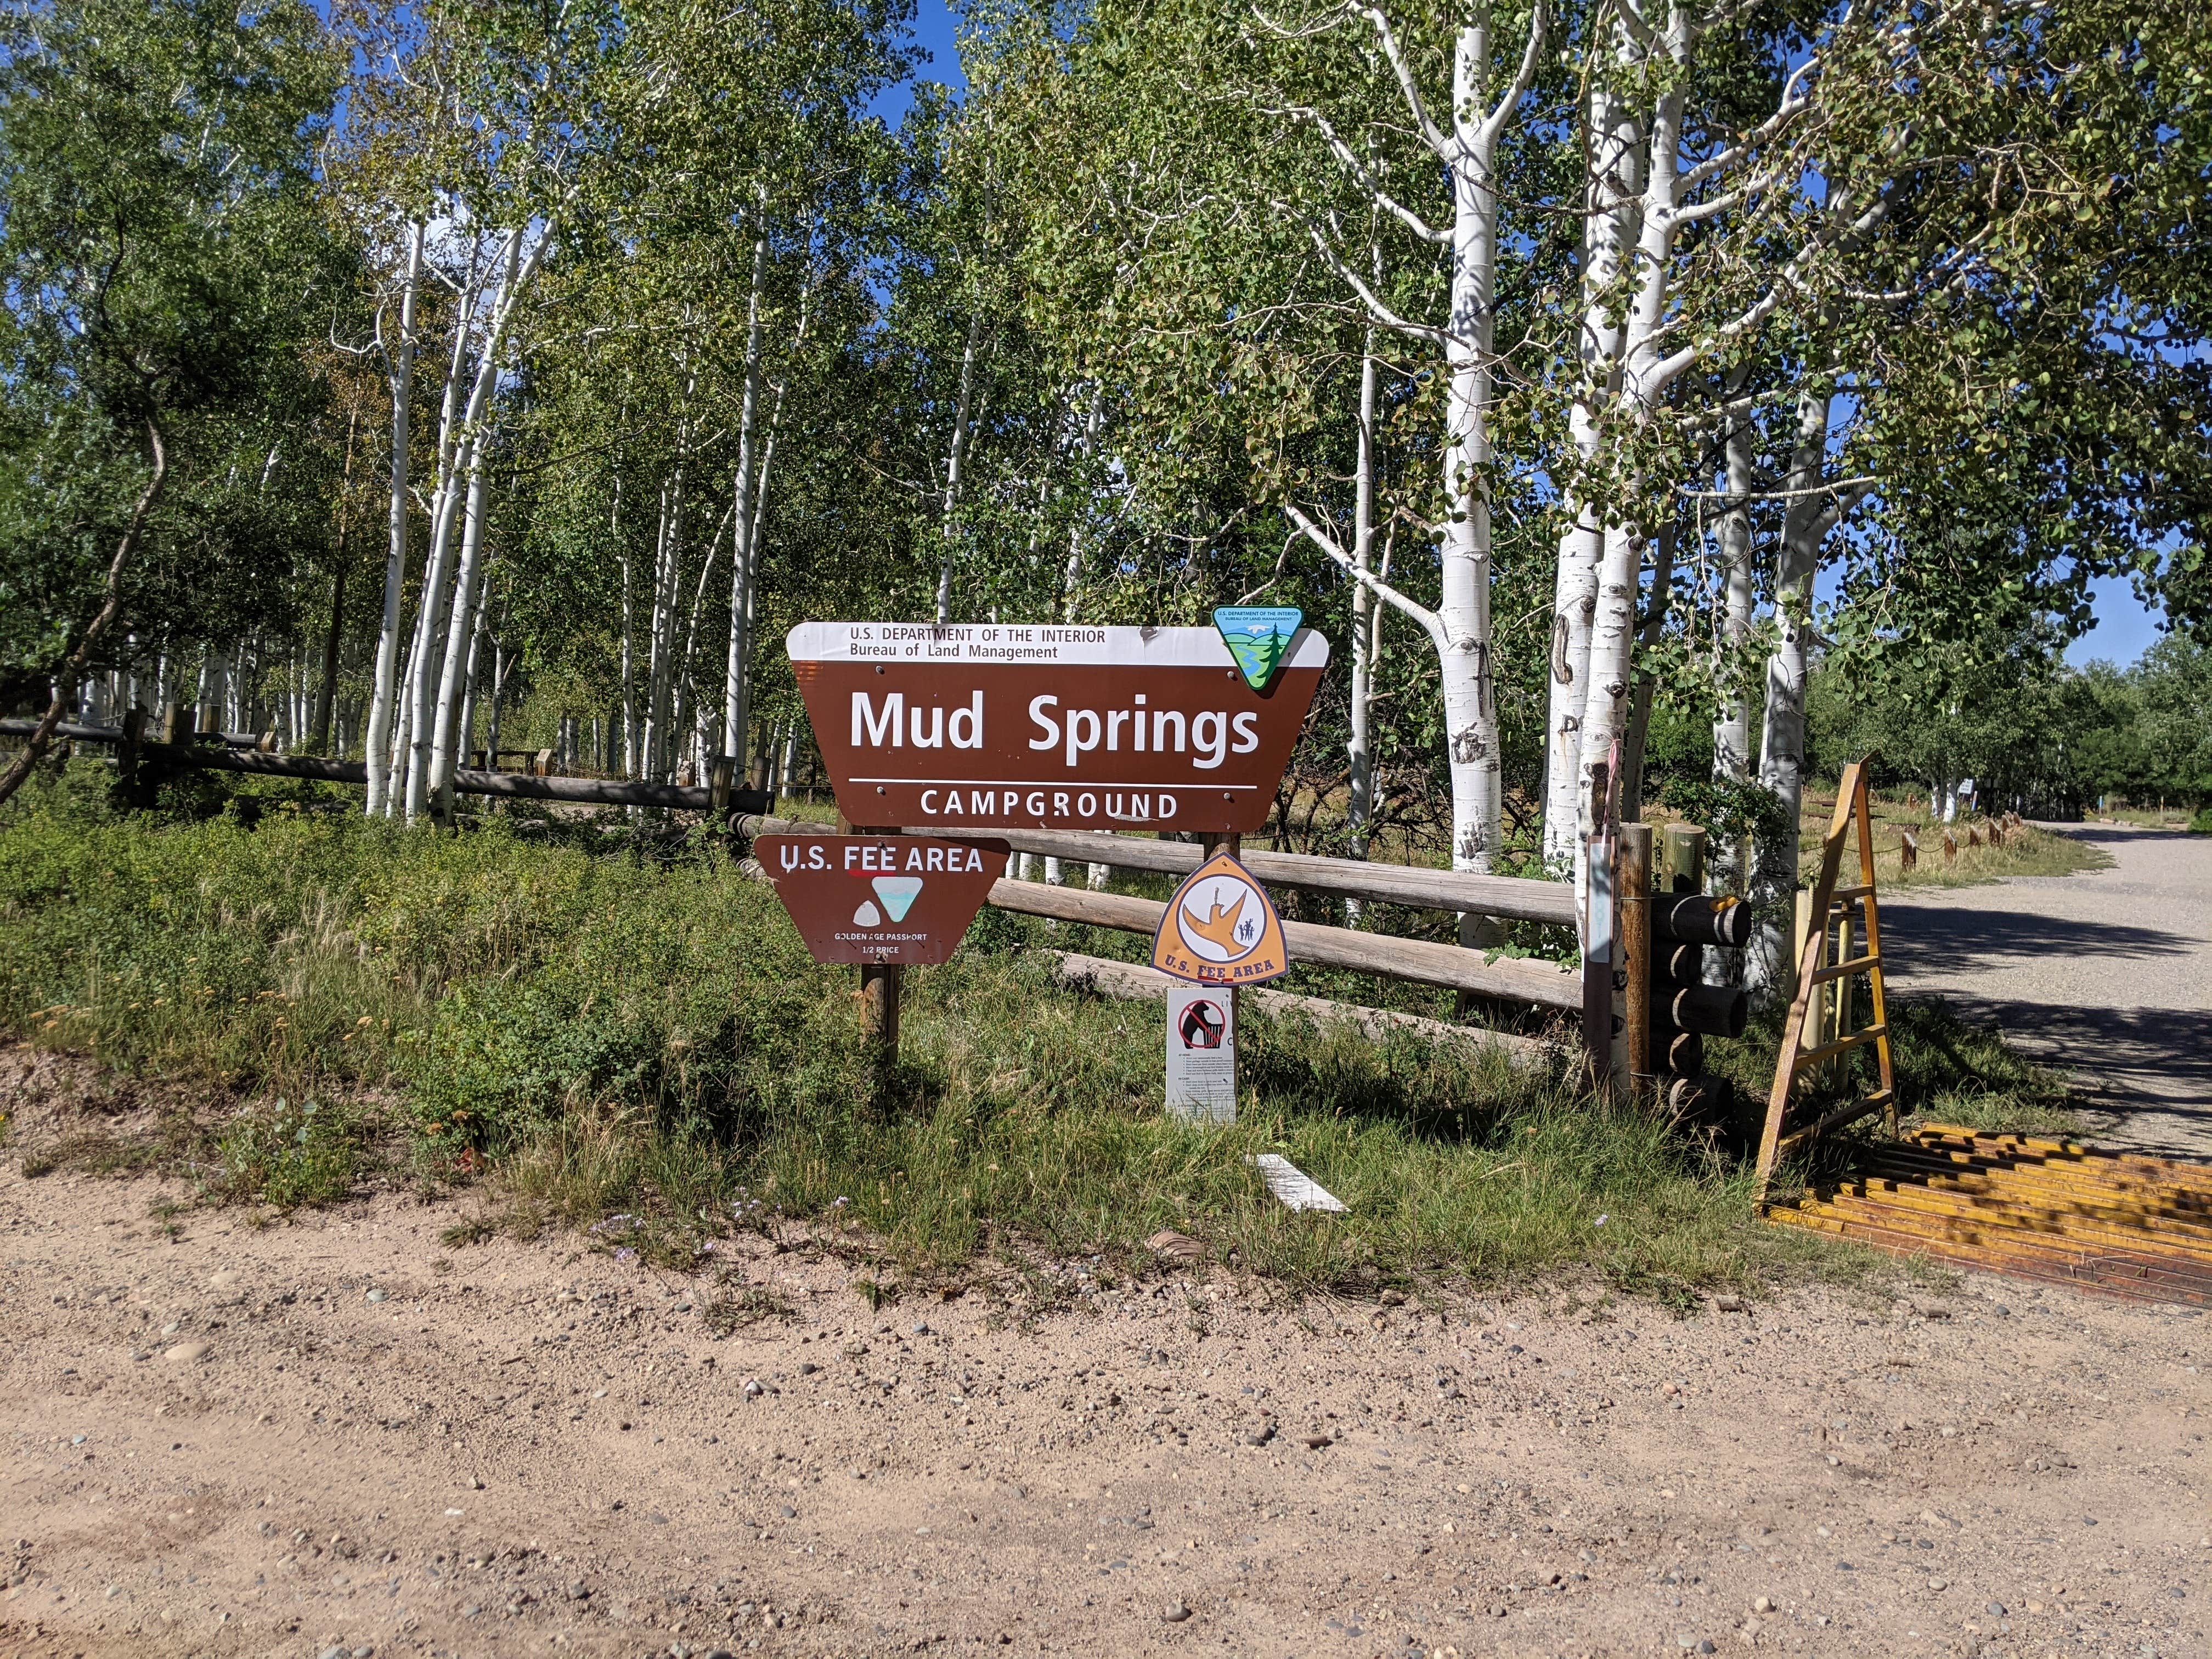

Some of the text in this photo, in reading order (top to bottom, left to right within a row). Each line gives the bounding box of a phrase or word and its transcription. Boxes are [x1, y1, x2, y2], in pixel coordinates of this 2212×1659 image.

[850, 627, 1105, 643] U.S. DEPARTMENT OF THE INTERIOR
[850, 643, 1058, 661] Bureau of Land Management
[851, 690, 1259, 769] Mud Springs
[921, 789, 1177, 819] CAMPGROUND
[780, 845, 984, 872] U.S. FEE AREA
[1165, 954, 1274, 978] U.S. FEE AREA
